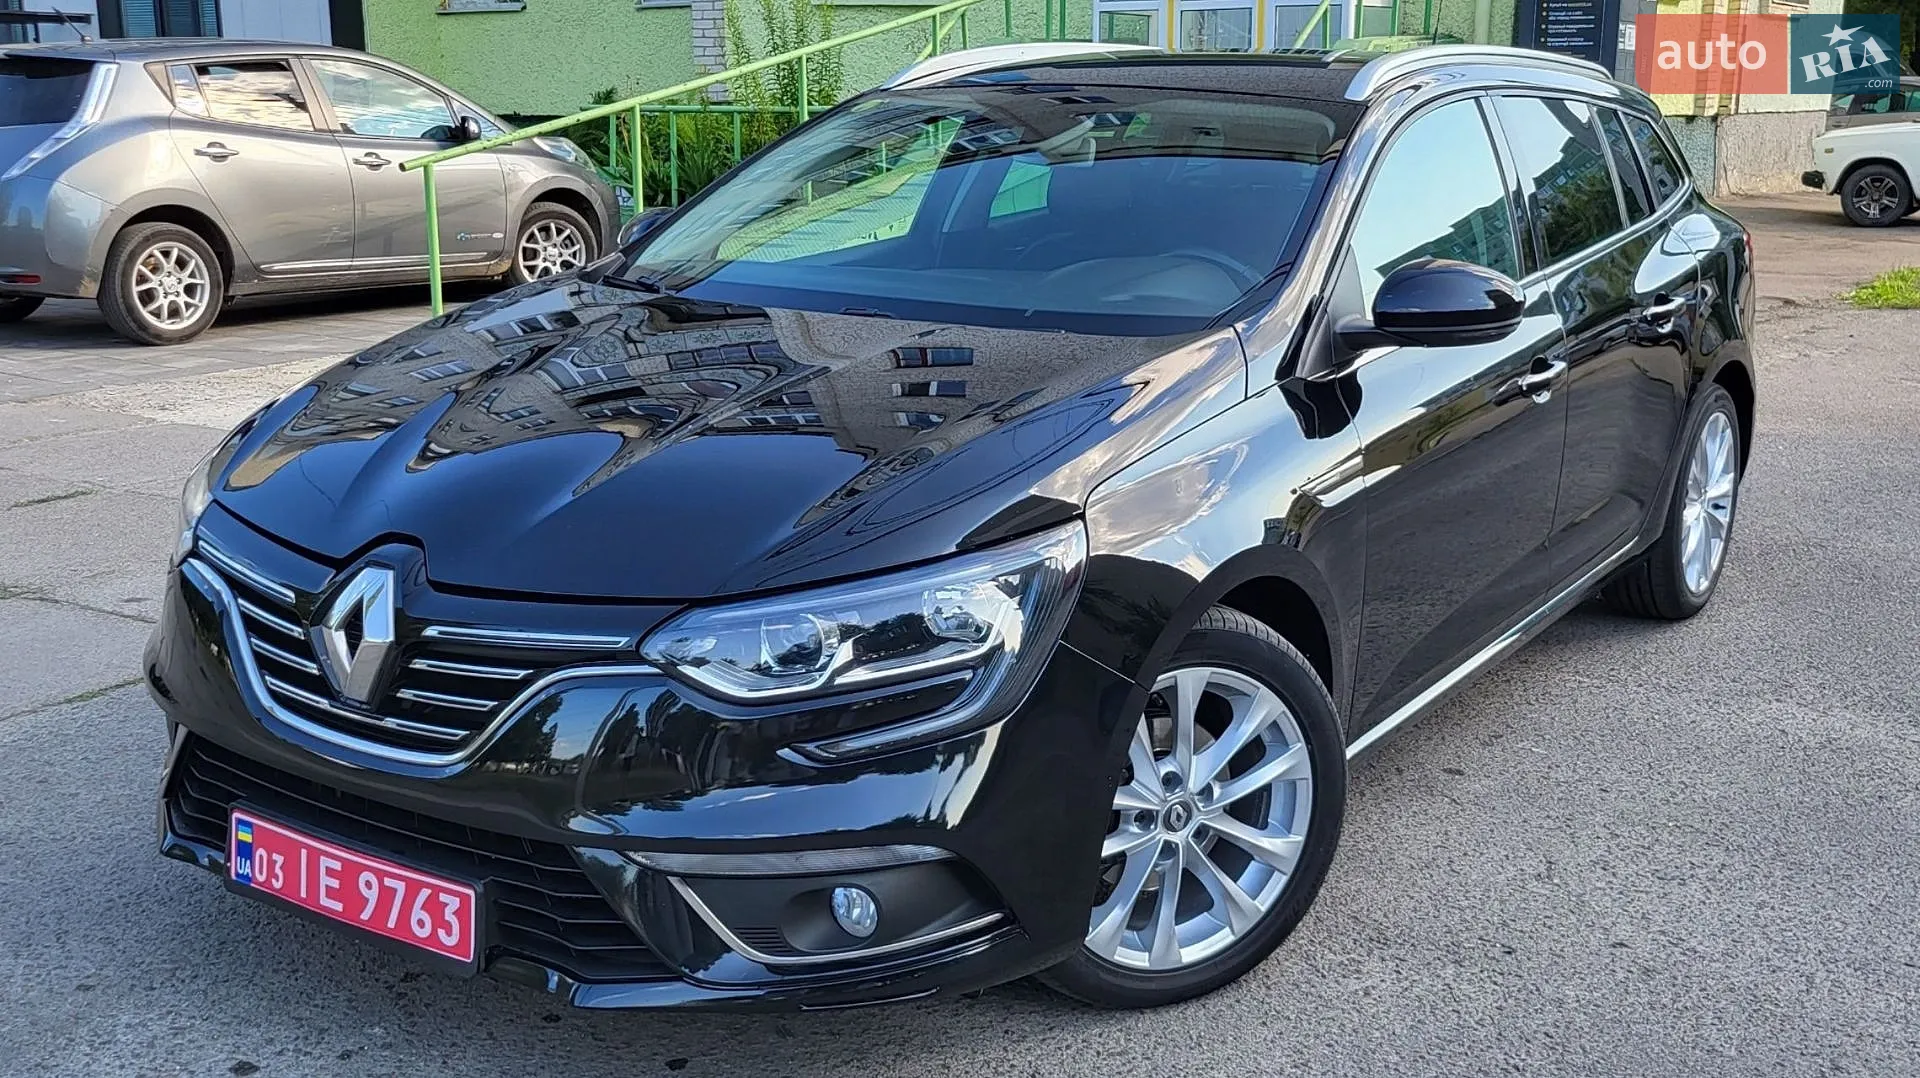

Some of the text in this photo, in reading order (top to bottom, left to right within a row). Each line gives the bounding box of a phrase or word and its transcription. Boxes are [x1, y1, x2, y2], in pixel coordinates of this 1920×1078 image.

[237, 855, 253, 878] UA
[254, 847, 461, 947] 03 IE 9763
